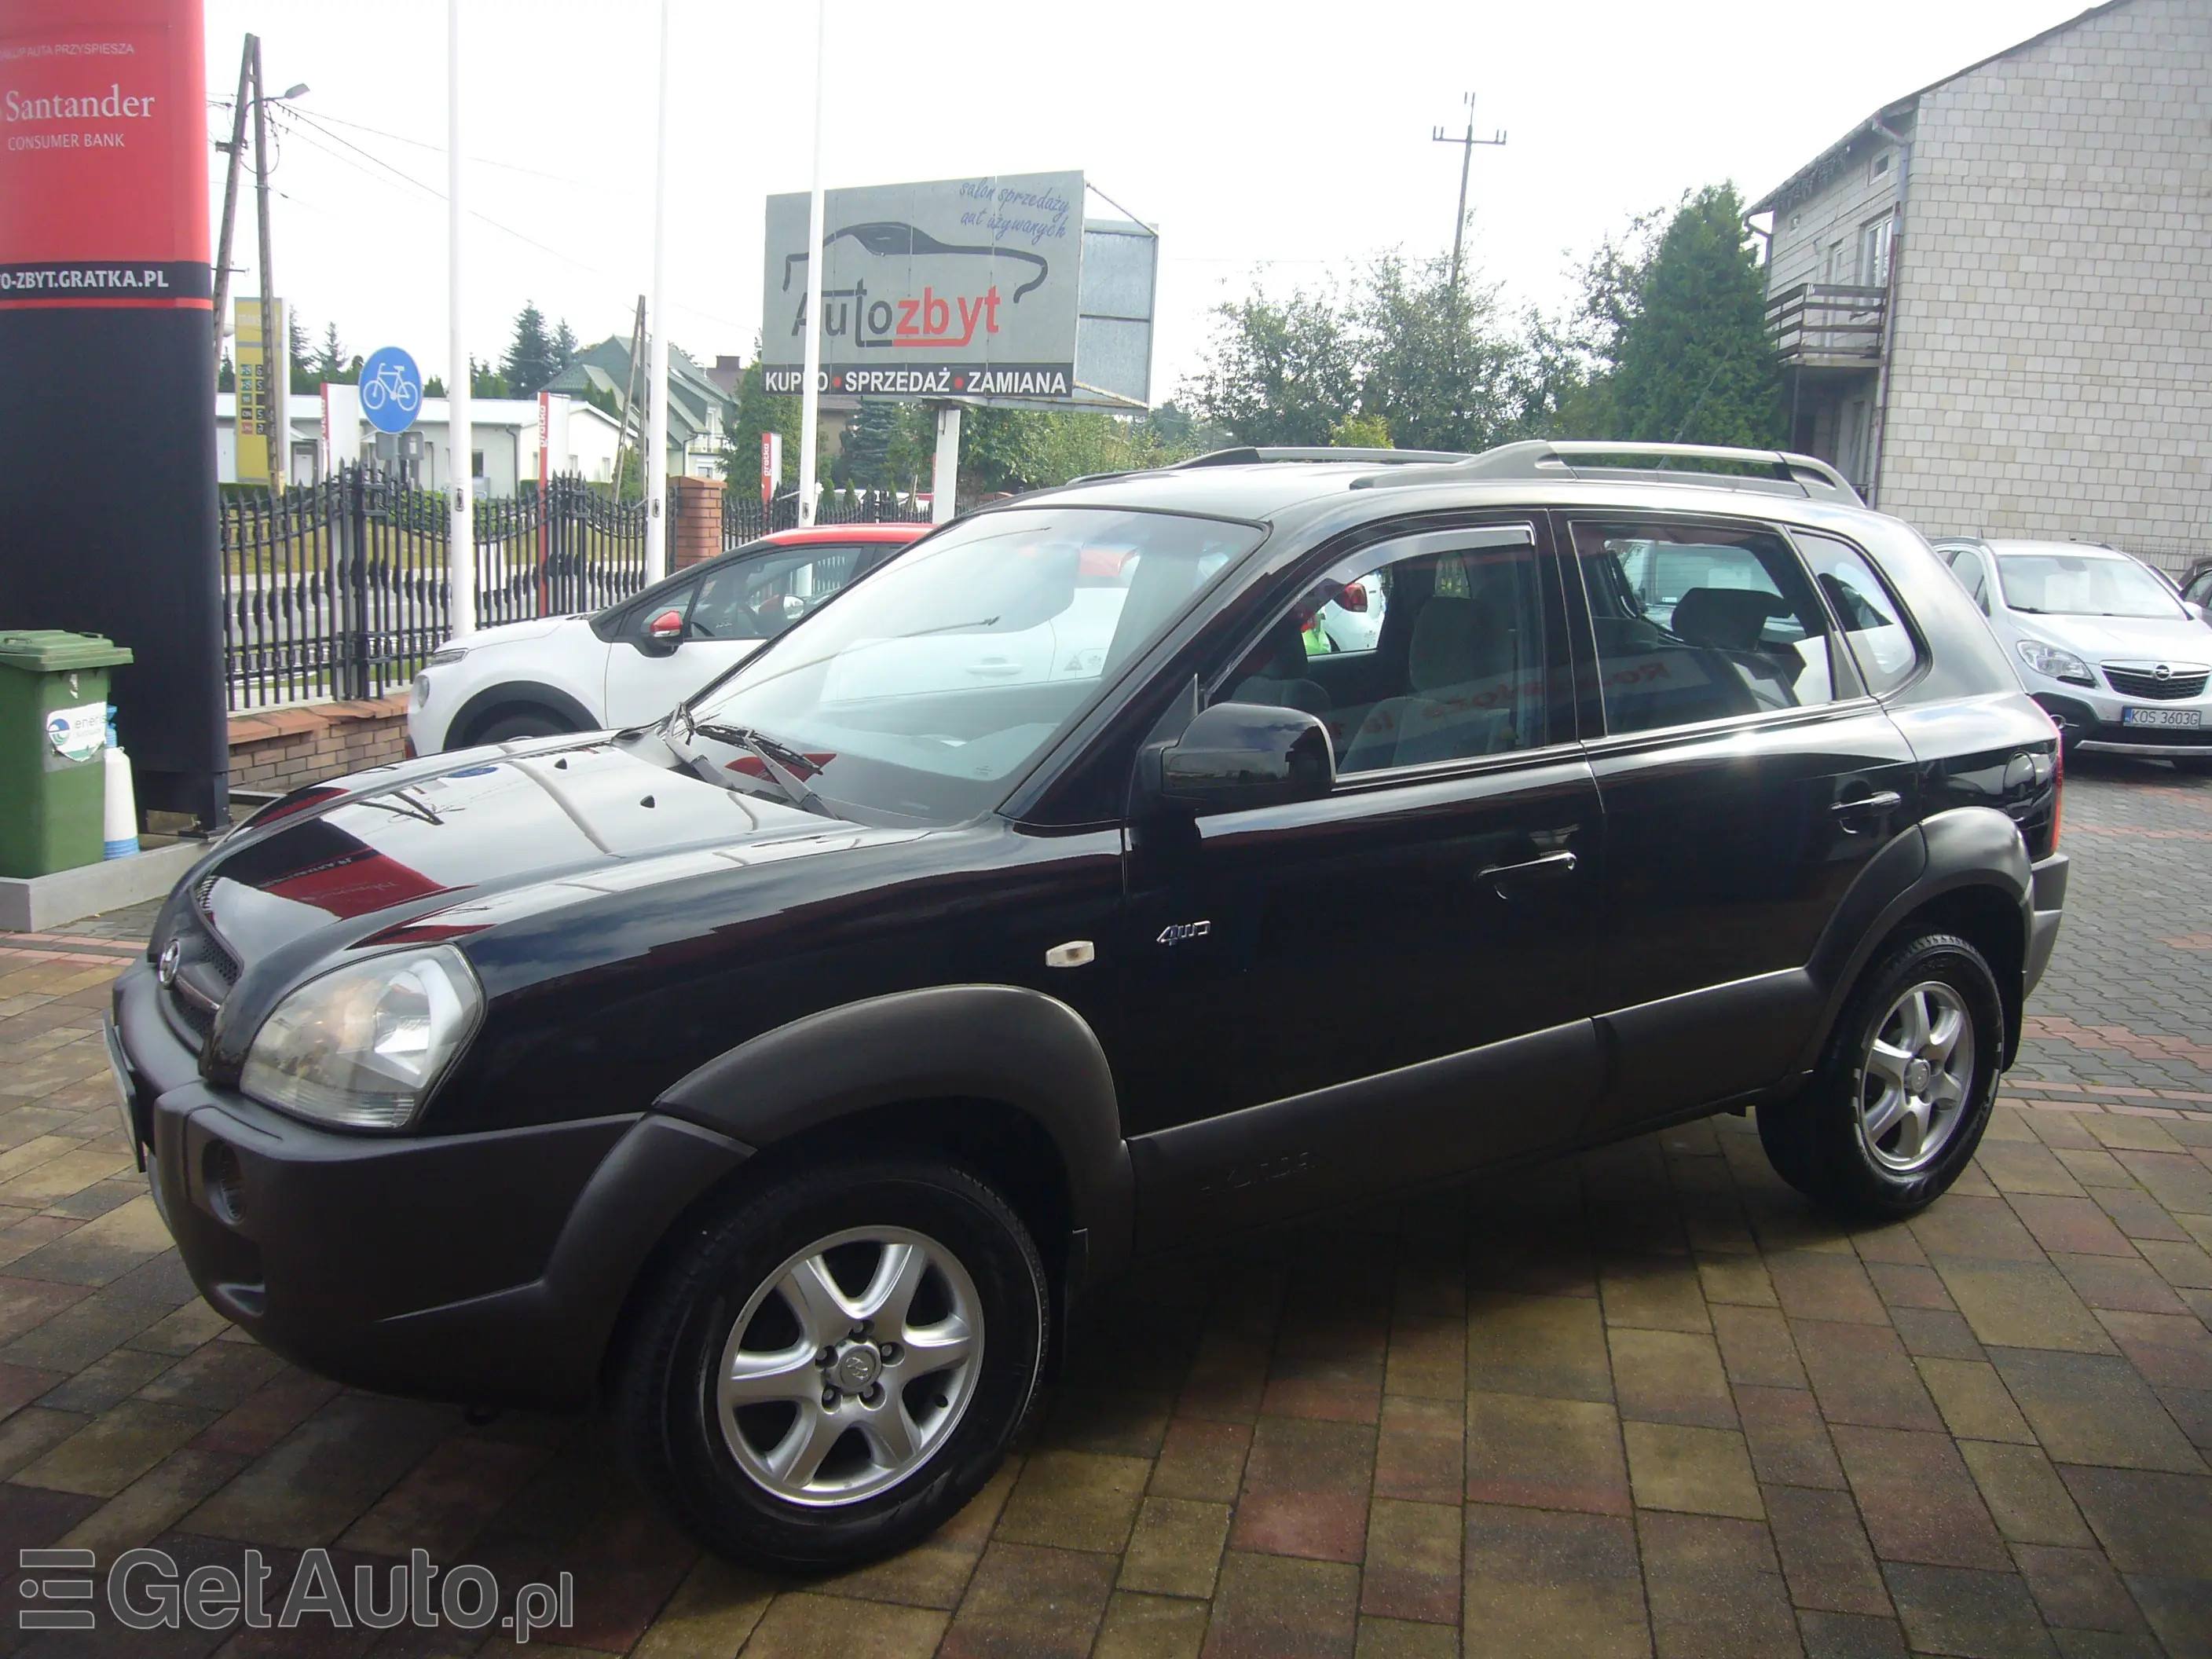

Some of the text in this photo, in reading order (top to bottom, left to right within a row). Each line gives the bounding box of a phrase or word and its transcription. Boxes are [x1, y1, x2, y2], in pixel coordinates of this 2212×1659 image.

[27, 46, 53, 57] AUTA
[55, 43, 134, 55] PRZYSPIESZA
[6, 83, 155, 122] Santander
[8, 133, 125, 151] CONSUMER BANK
[959, 178, 1069, 222] salon sprzedaży
[961, 208, 987, 226] aut
[0, 270, 169, 290] O-ZBYT.GRATKA.PL
[766, 366, 1067, 394] KUPO SPRZEDAŻ ZAMIANA
[2132, 710, 2156, 723] KOS
[2160, 712, 2199, 725] 3603G
[1156, 920, 1211, 946] 4WD
